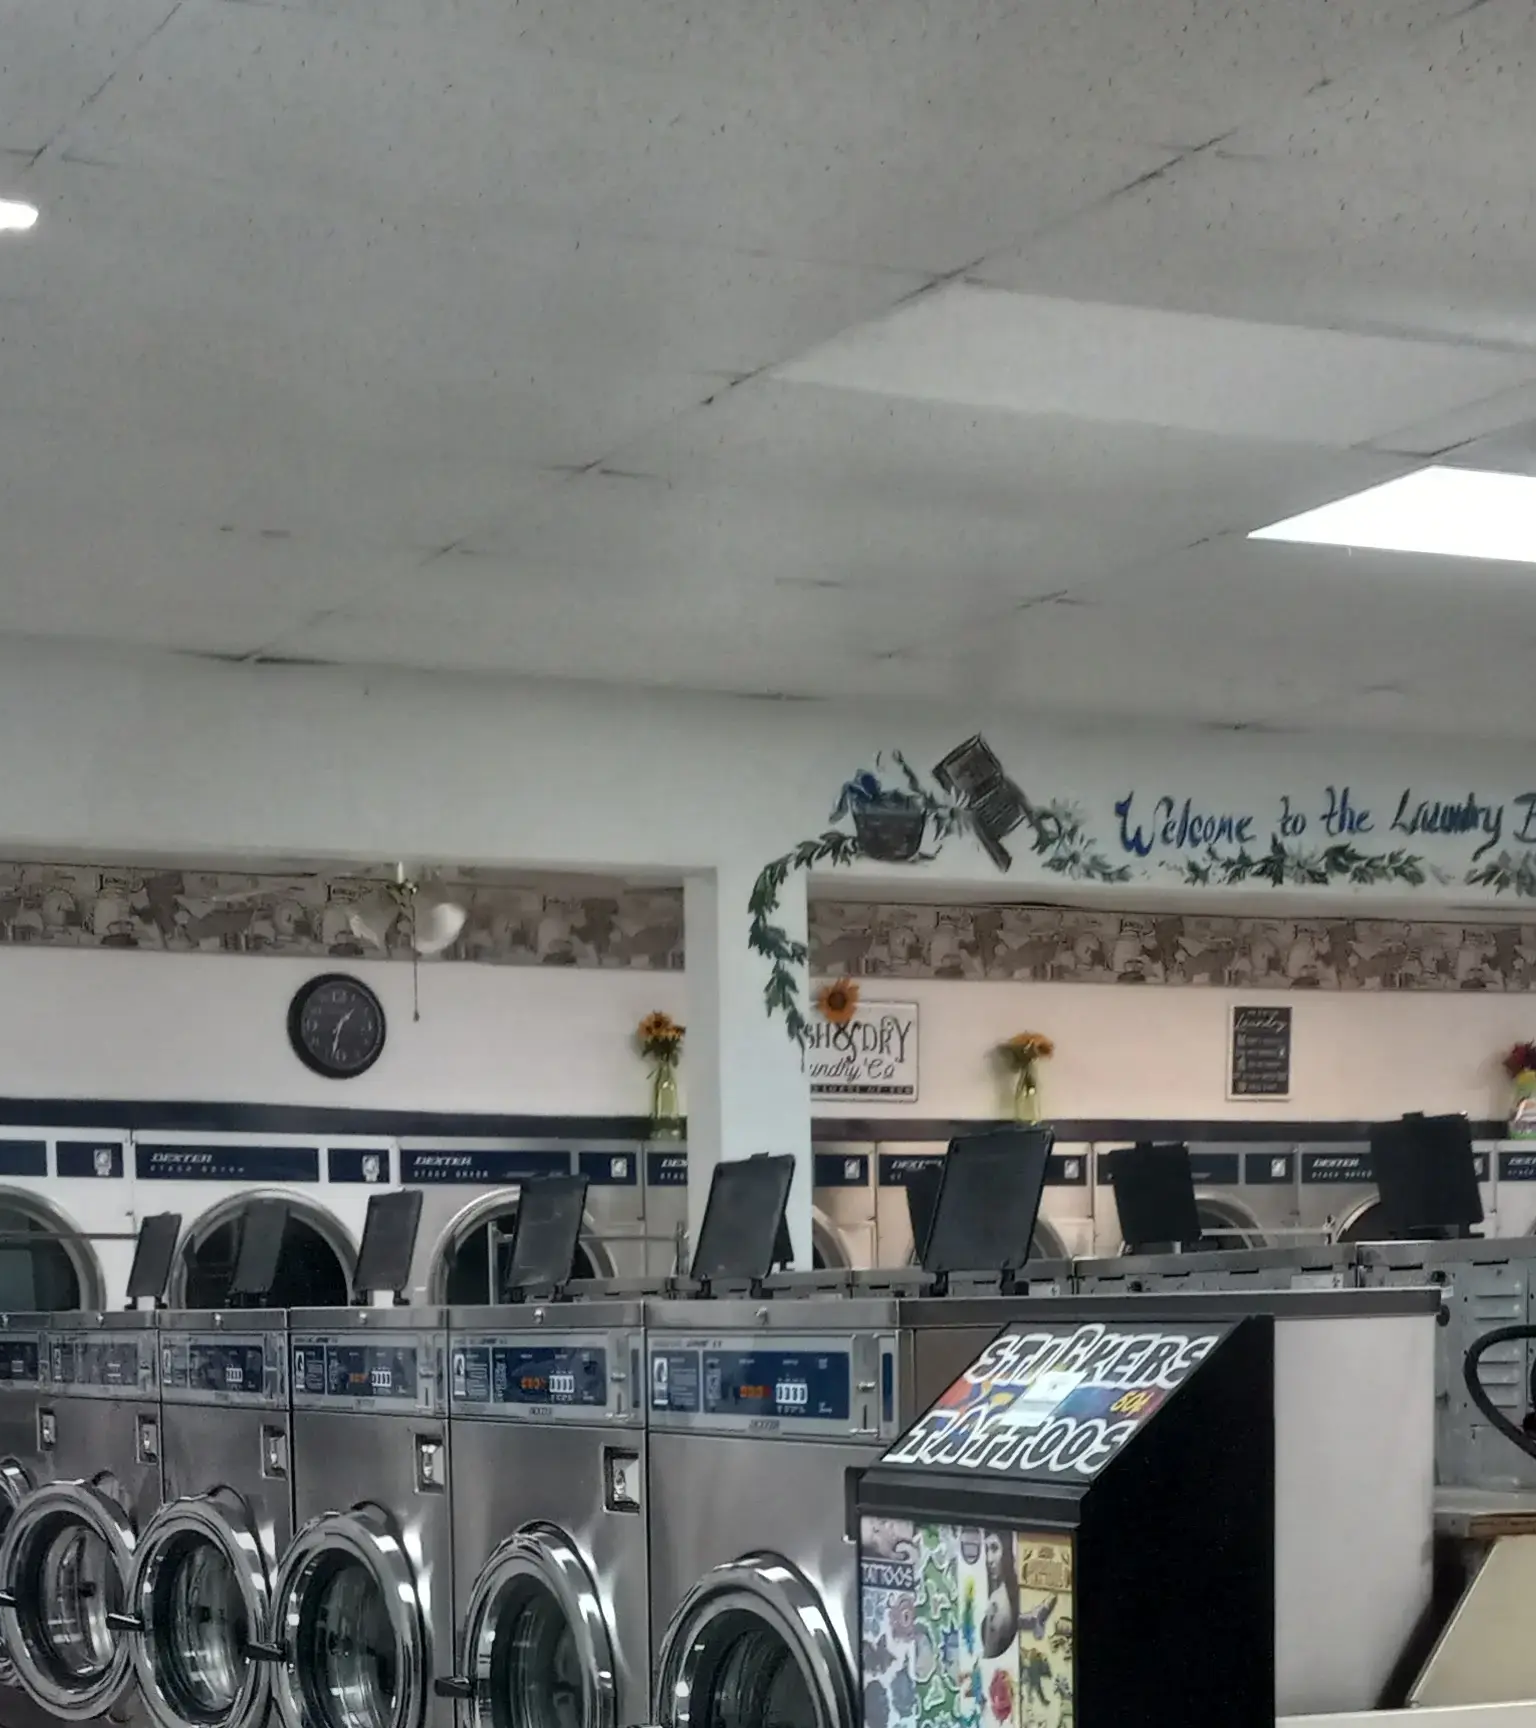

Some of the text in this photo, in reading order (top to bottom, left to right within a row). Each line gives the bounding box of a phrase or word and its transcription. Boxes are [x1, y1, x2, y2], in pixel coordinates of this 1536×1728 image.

[1114, 785, 1257, 858] Welcome
[1277, 796, 1307, 840] to
[1320, 785, 1375, 837] the
[150, 1153, 213, 1164] DEXTER
[965, 1322, 1220, 1390] STICKERS
[881, 1404, 1142, 1475] TATTOOS
